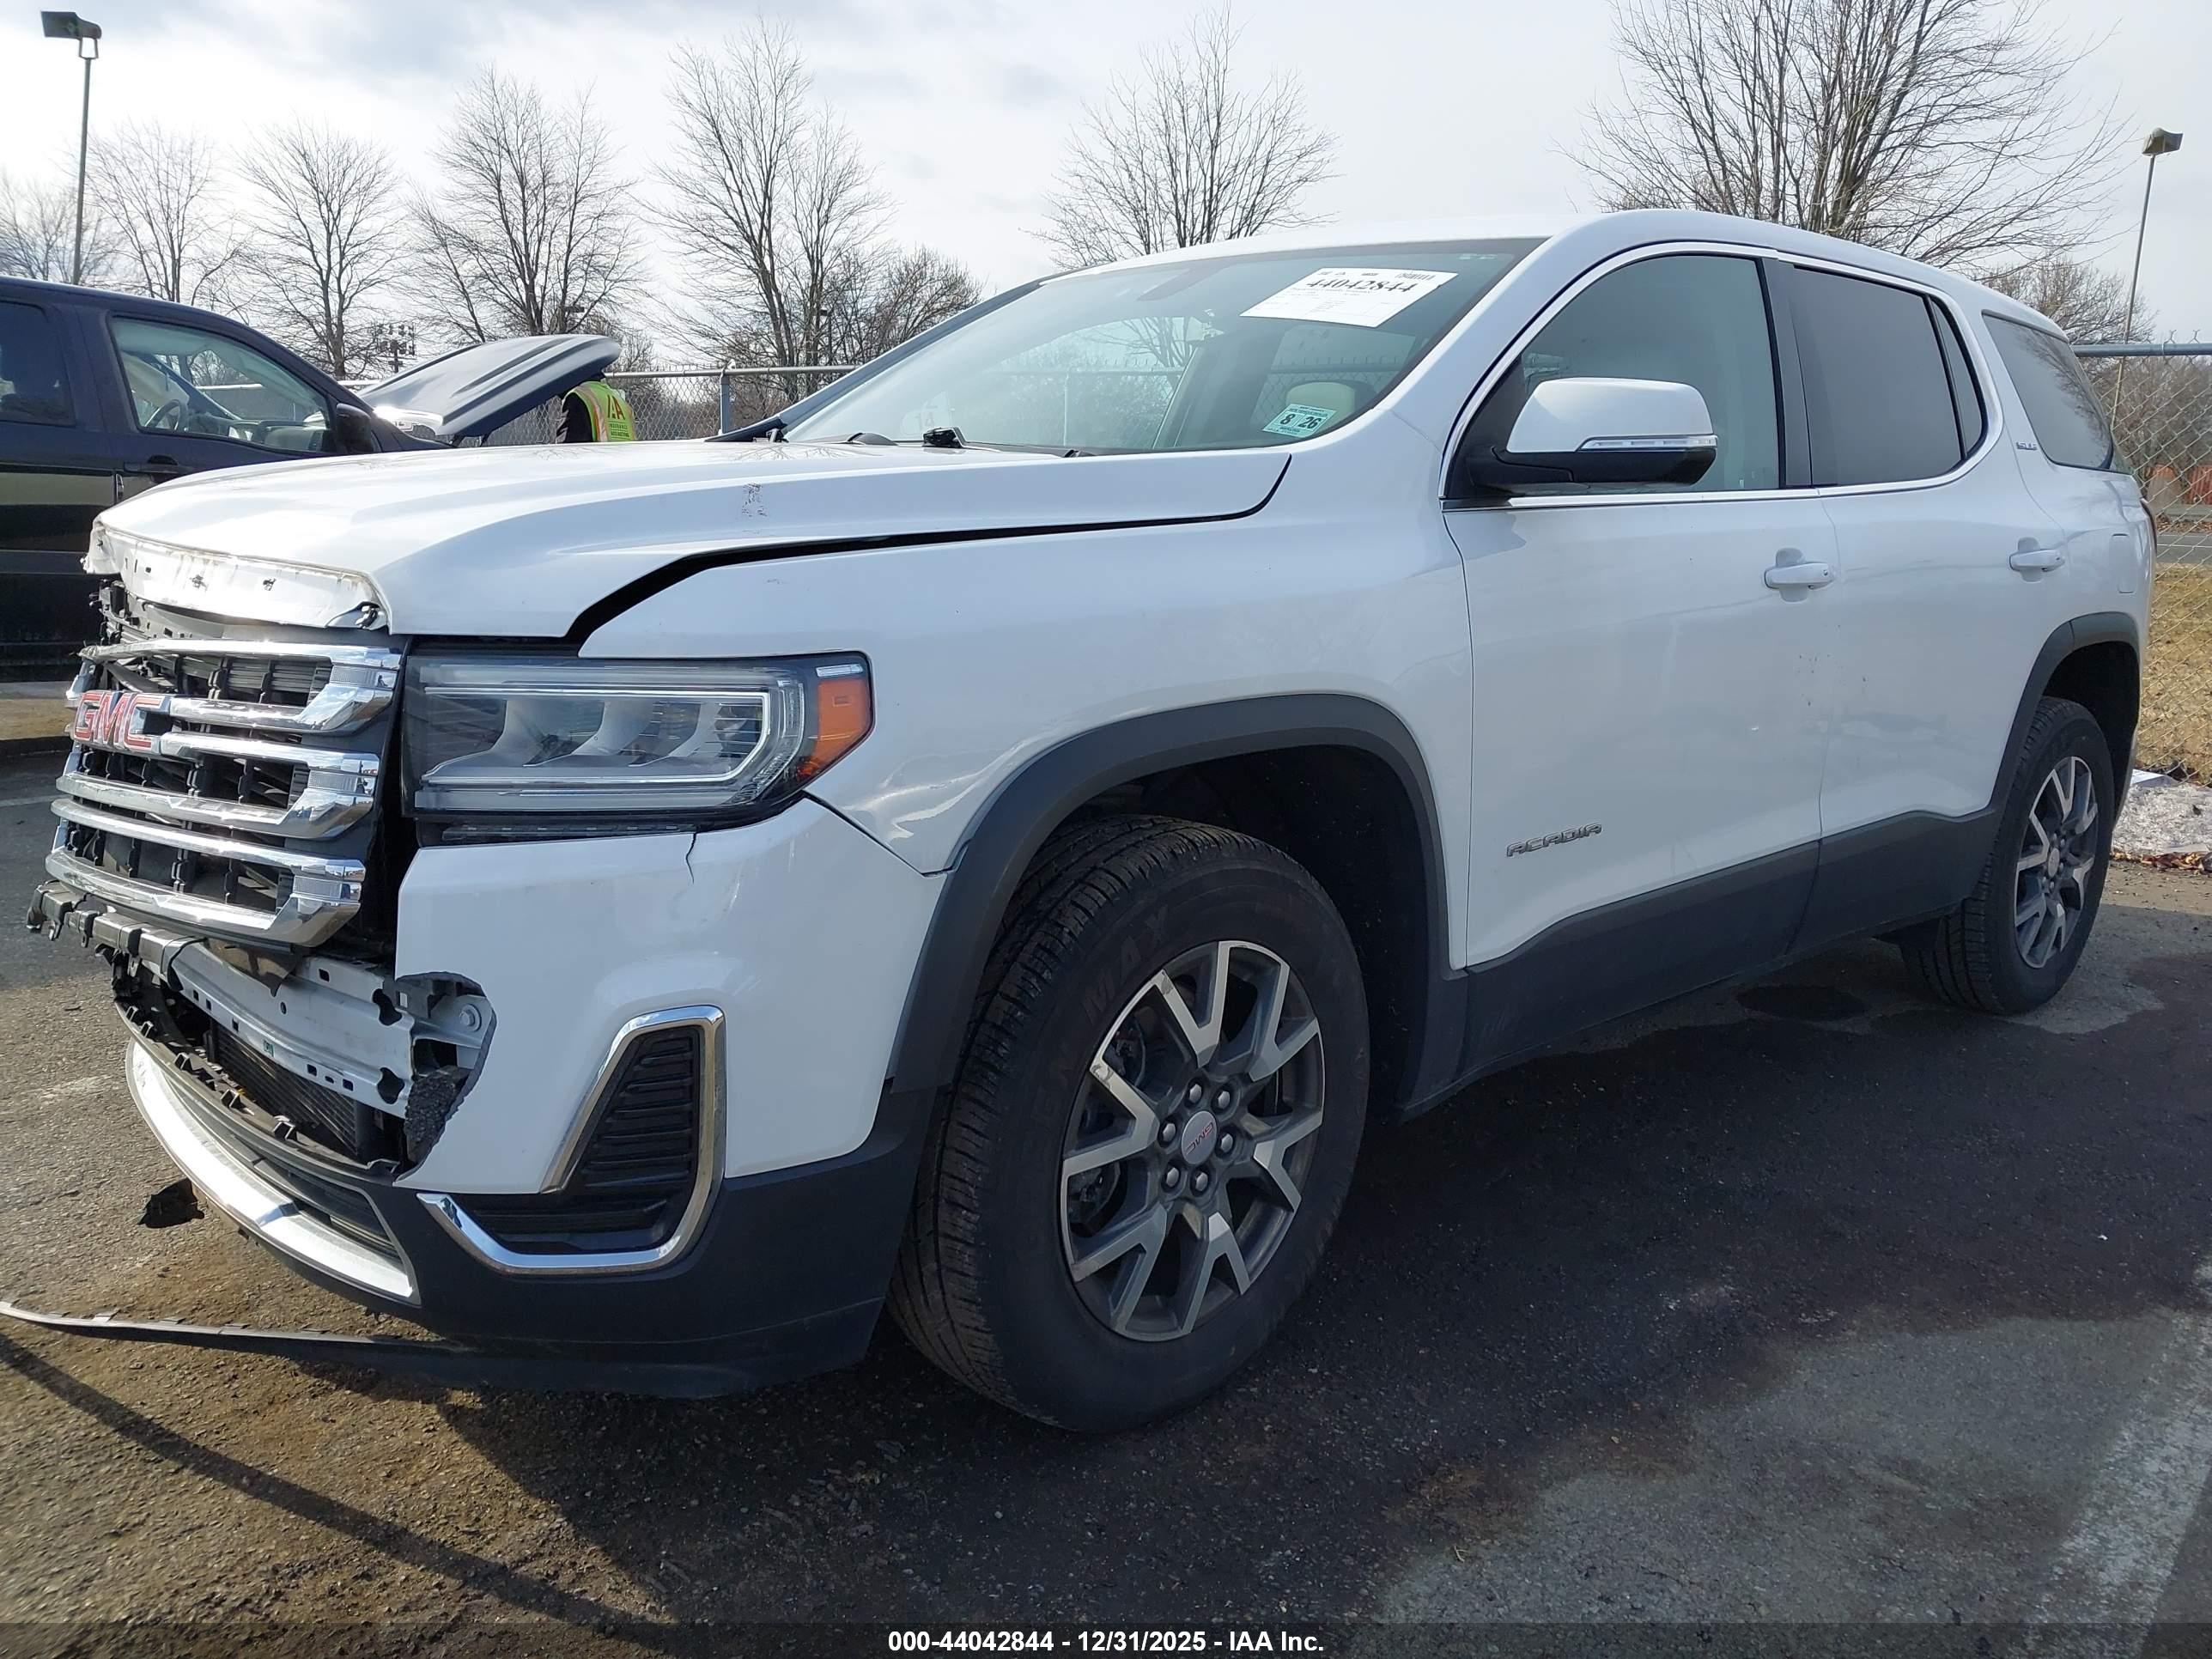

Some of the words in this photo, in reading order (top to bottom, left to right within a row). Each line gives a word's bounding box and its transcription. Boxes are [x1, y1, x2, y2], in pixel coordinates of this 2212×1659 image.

[1306, 278, 1419, 293] 44042844
[607, 394, 626, 420] IAA
[1279, 413, 1296, 425] 8
[1297, 416, 1322, 429] 26
[74, 690, 167, 752] GMC
[1506, 822, 1603, 858] ACADIA
[1185, 1121, 1215, 1156] GMC
